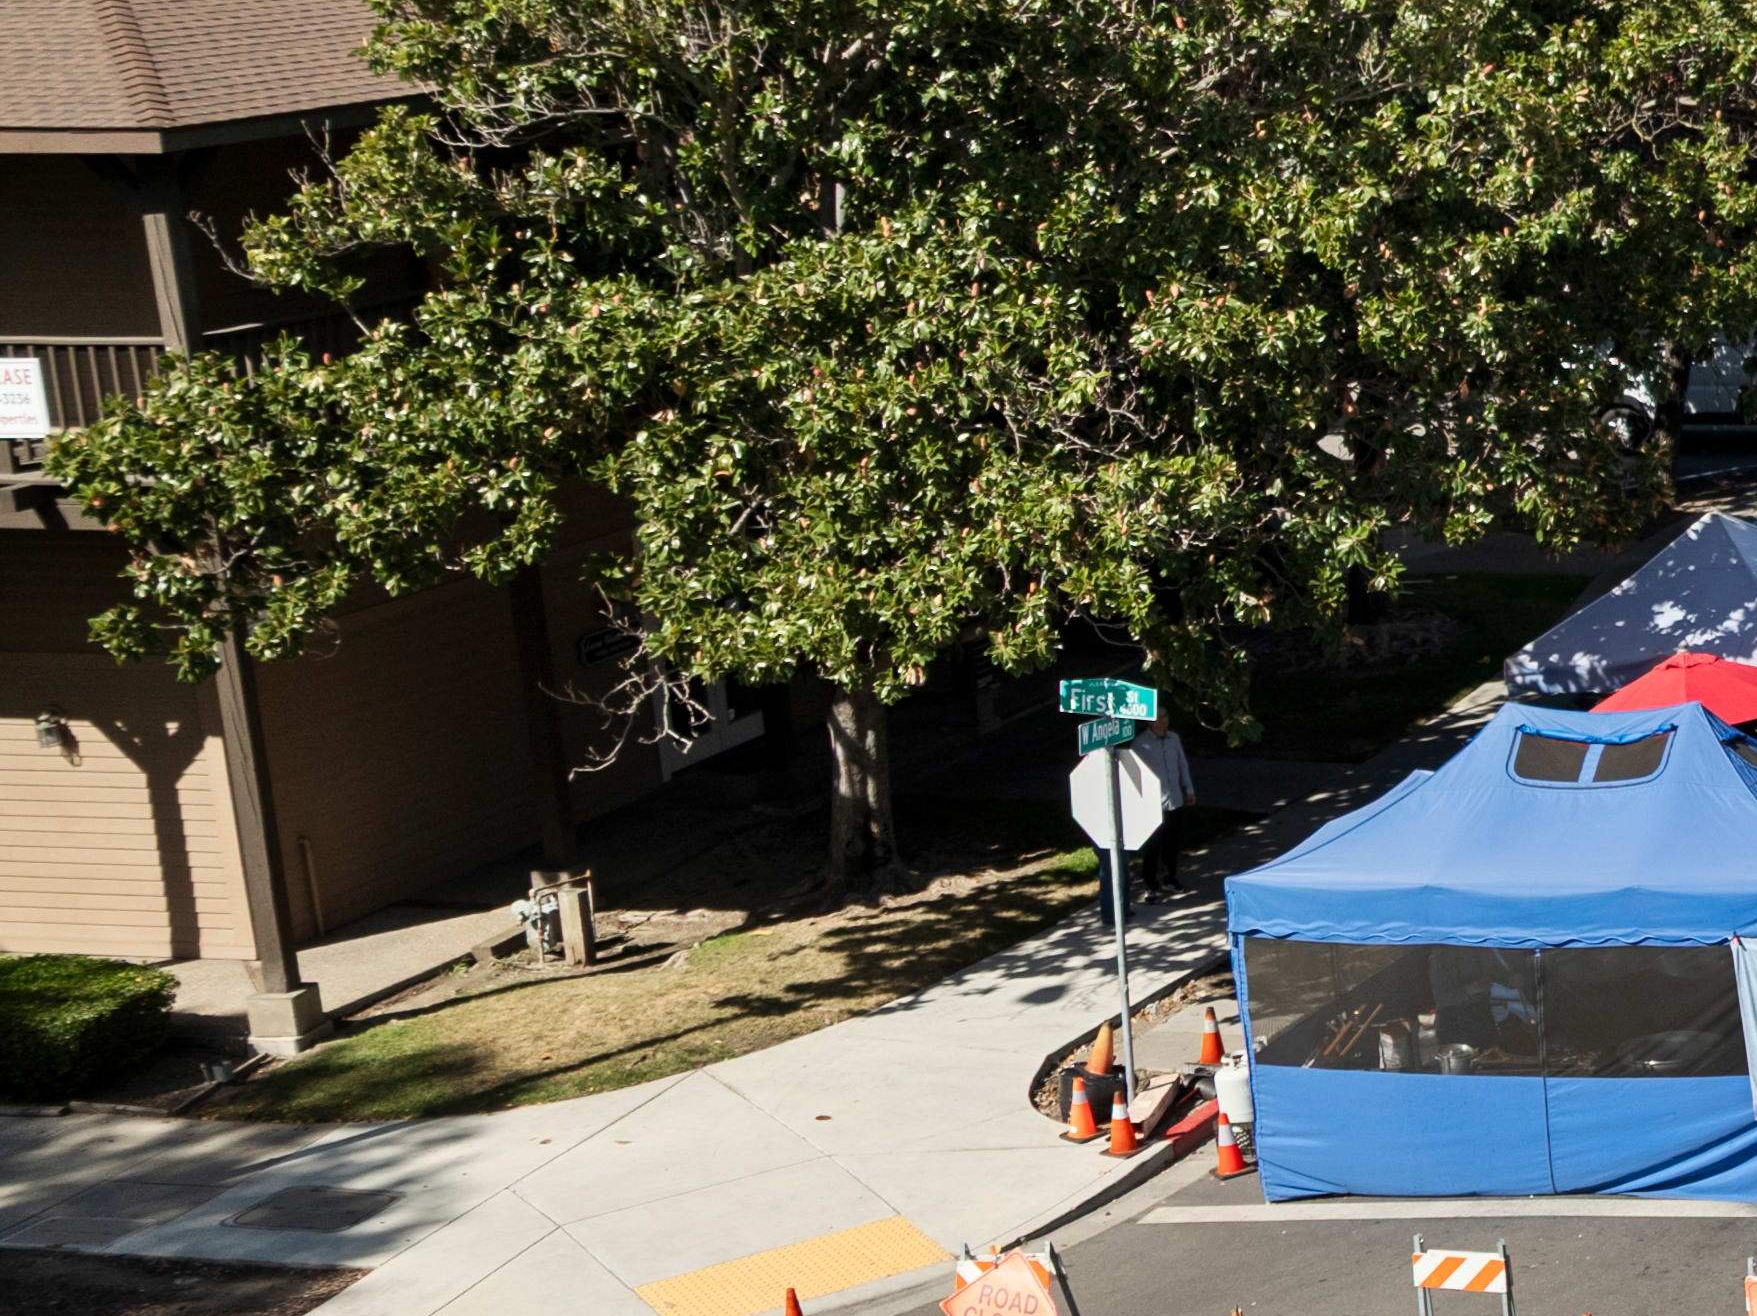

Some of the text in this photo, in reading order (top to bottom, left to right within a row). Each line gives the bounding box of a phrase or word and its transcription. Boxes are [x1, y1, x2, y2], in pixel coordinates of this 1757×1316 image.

[1070, 688, 1139, 715] First St
[979, 1284, 1039, 1315] ROAD
